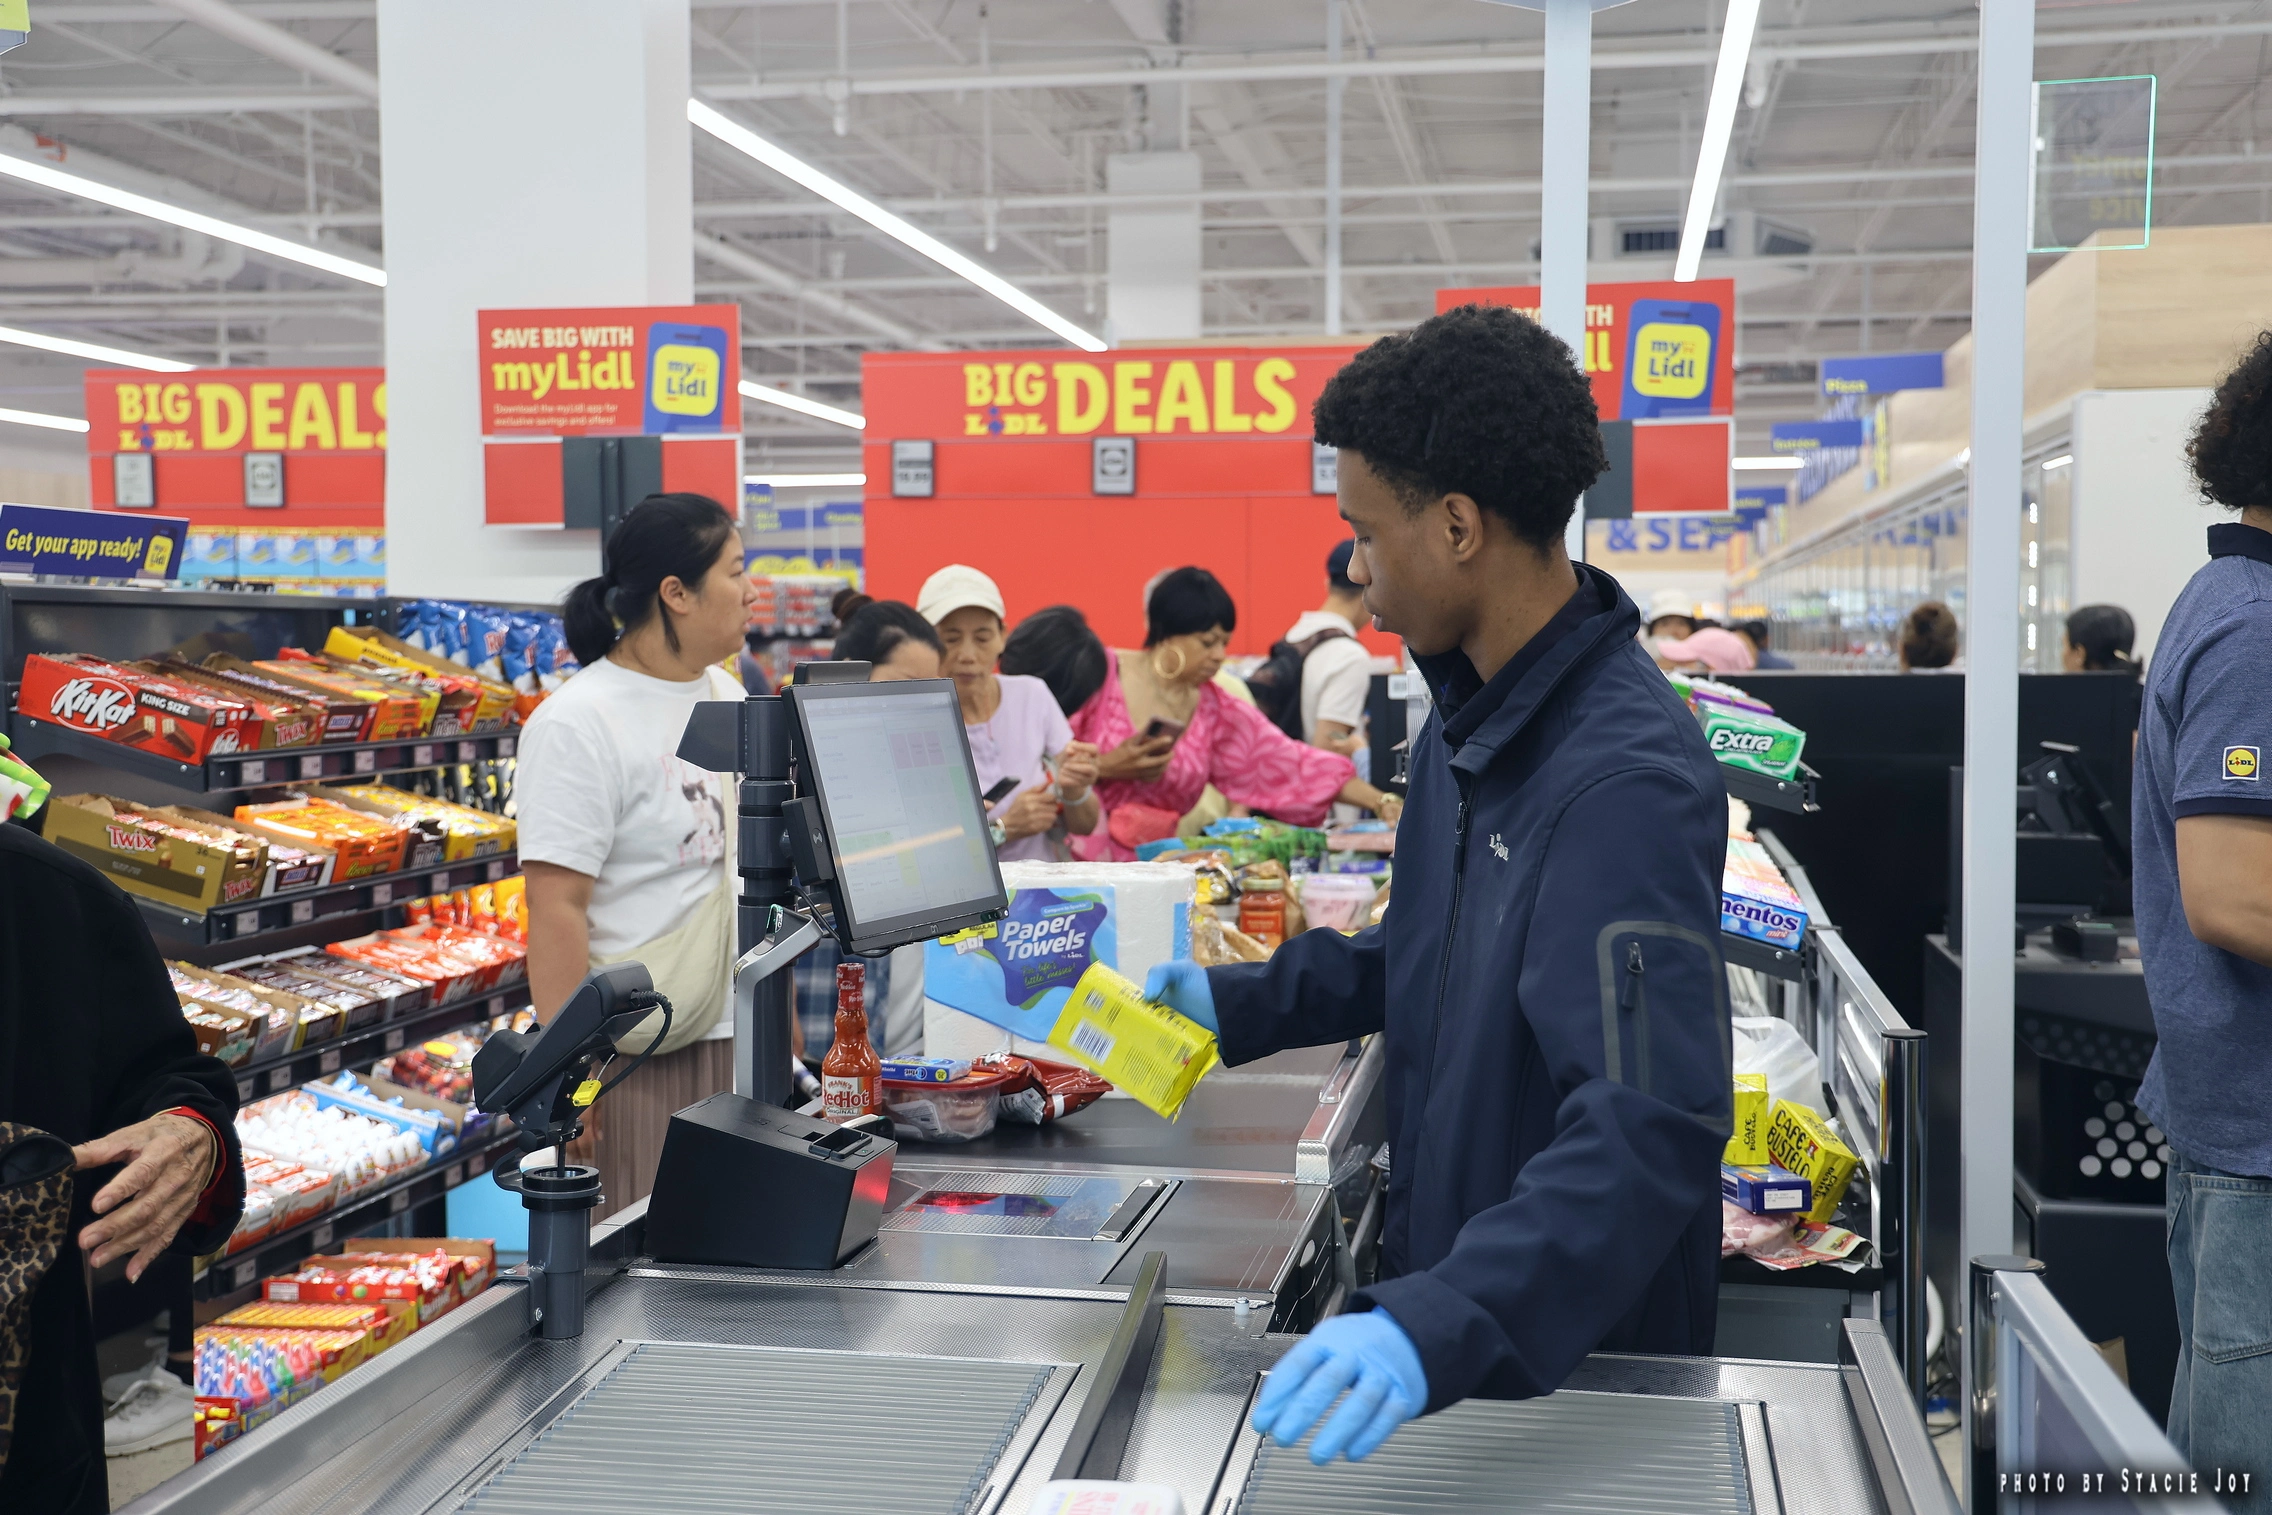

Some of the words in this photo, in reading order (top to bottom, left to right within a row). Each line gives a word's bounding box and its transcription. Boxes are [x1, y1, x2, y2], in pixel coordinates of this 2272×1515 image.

[491, 327, 541, 349] SAVE
[541, 326, 578, 348] BIG
[579, 325, 634, 347] WITH
[1651, 339, 1682, 357] my
[492, 349, 635, 400] myLidl
[667, 360, 696, 377] my
[1649, 358, 1695, 379] Lidl
[667, 377, 707, 398] Lidl
[963, 362, 1048, 407] BIG
[1052, 357, 1298, 435] DEALS
[115, 382, 193, 424] BIG
[964, 407, 1048, 436] LIDL
[119, 424, 195, 450] LIDL
[5, 528, 33, 552] Get
[32, 536, 70, 558] your
[69, 538, 99, 561] app
[99, 536, 144, 563] ready!
[1608, 518, 1638, 551] &
[51, 678, 137, 730] KitKat
[141, 691, 167, 710] KING
[167, 700, 192, 717] SIZE
[274, 719, 308, 748] Twix
[1710, 728, 1775, 751] Extra
[2228, 756, 2254, 766] LIDL
[106, 824, 157, 852] Twix
[224, 875, 253, 902] Twix
[1002, 914, 1077, 942] Paper
[1005, 929, 1087, 960] Towels
[828, 1080, 853, 1090] FRANK'S
[1767, 1125, 1811, 1179] BUSTELO
